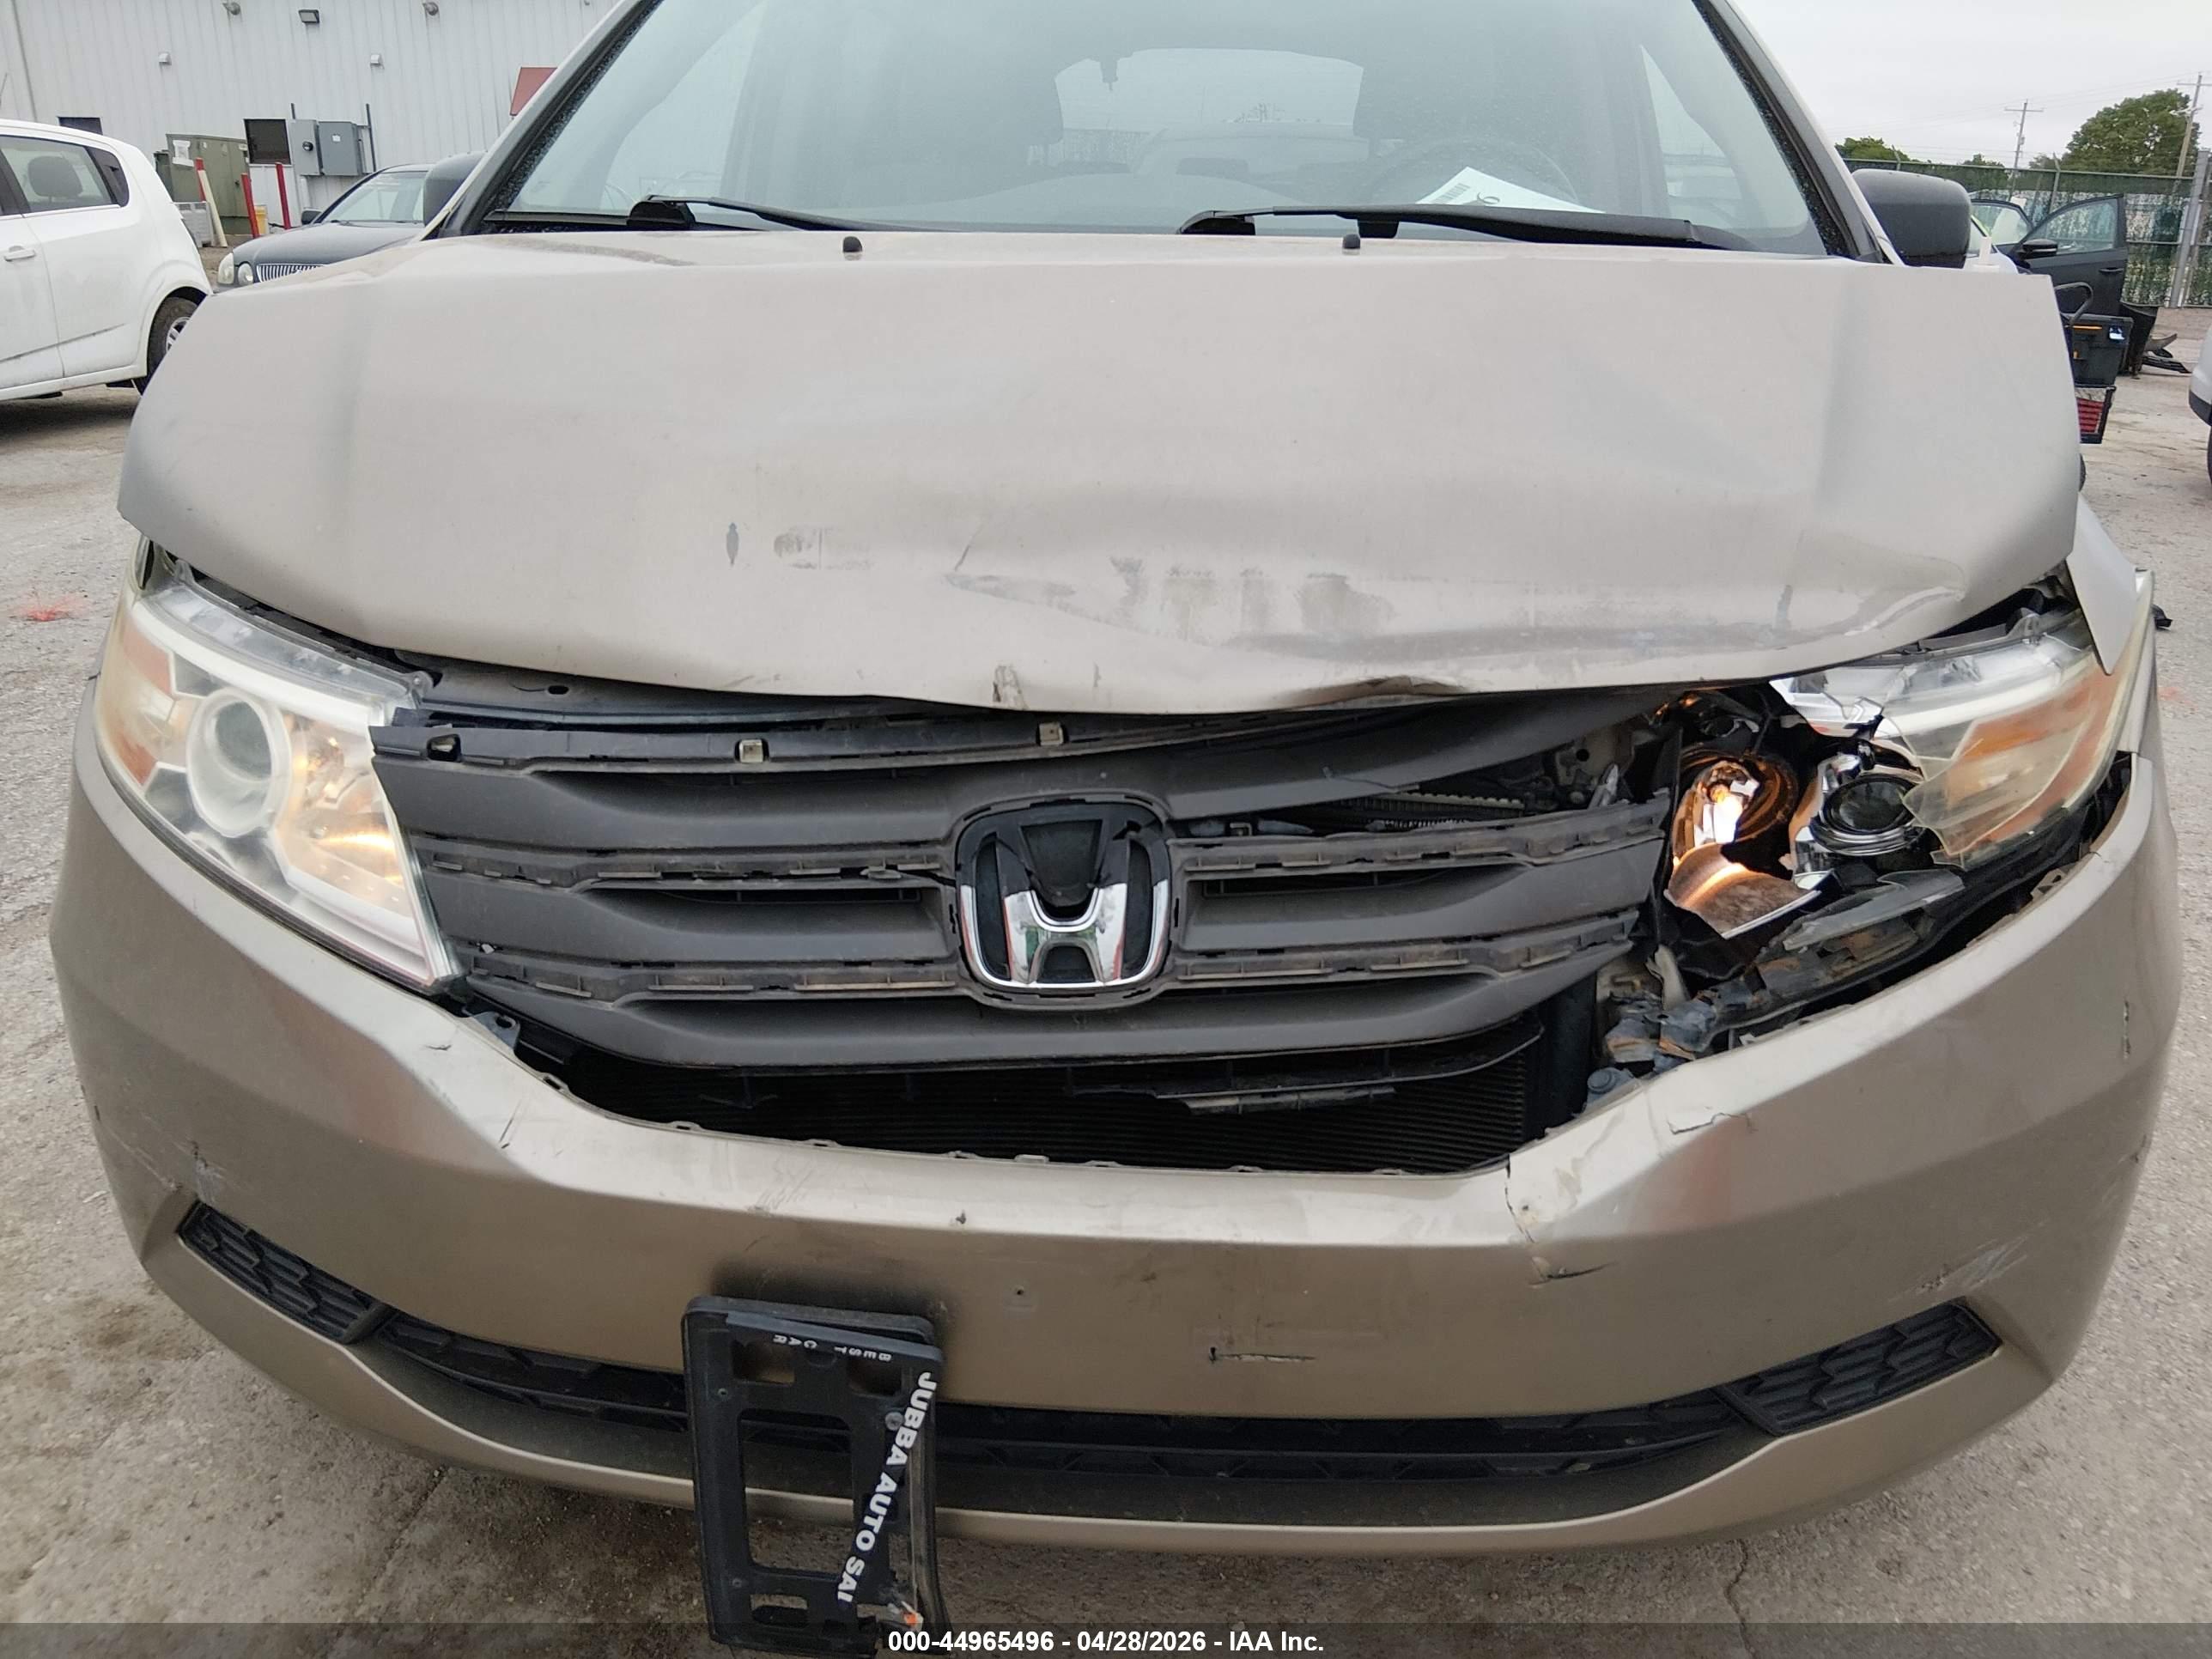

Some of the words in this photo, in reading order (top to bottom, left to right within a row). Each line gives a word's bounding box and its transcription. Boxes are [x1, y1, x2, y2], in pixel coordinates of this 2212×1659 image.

[773, 1334, 817, 1349] CAR
[834, 1346, 892, 1362] BEST
[885, 1371, 937, 1466] JUBBA
[855, 1472, 897, 1552] AUTO
